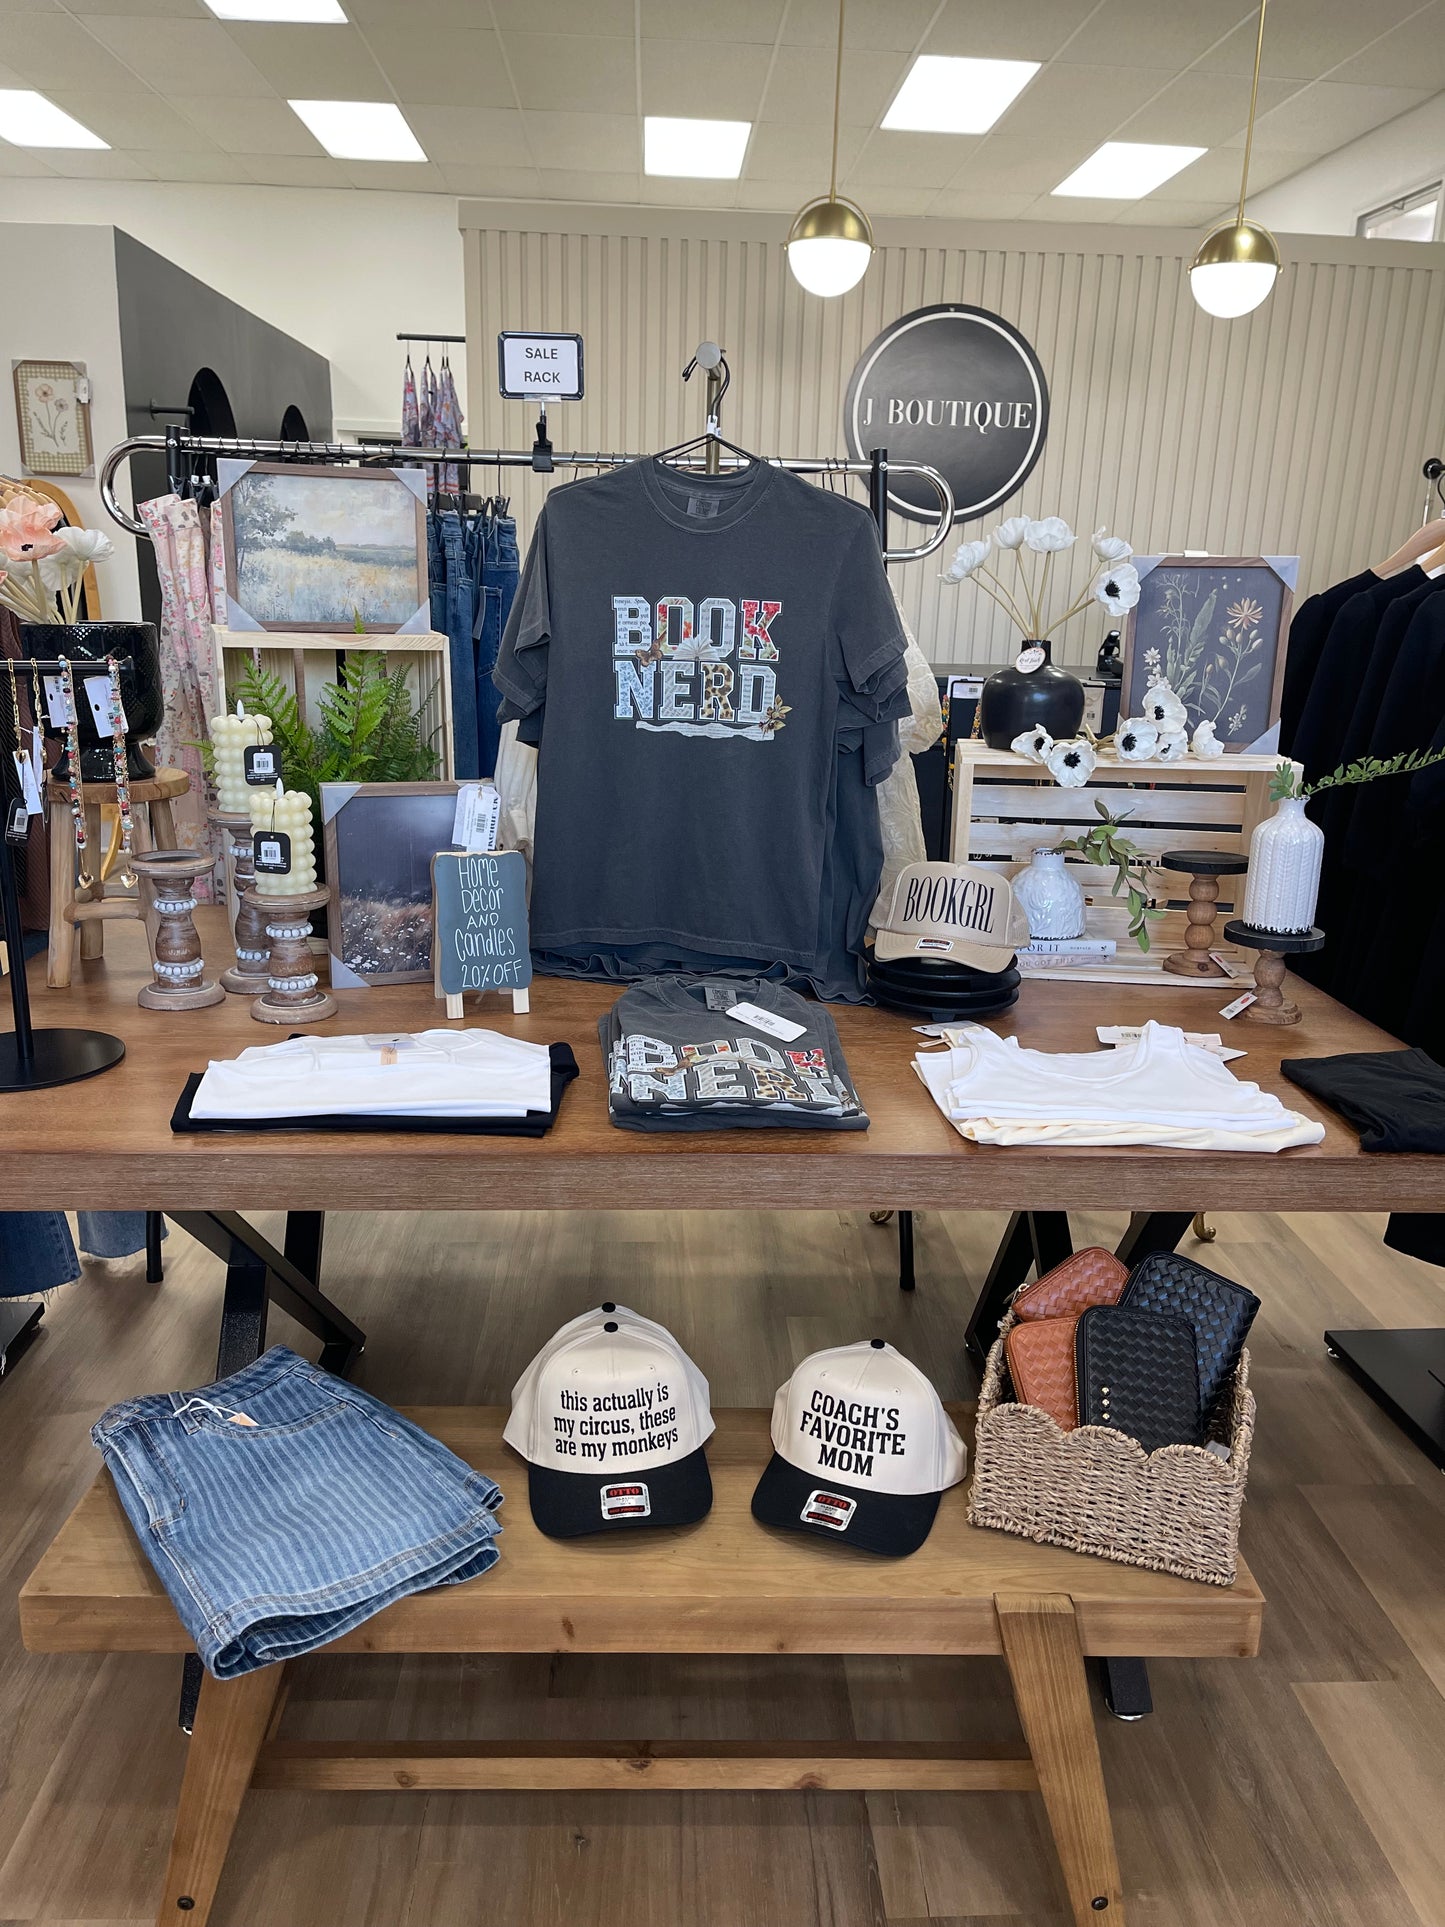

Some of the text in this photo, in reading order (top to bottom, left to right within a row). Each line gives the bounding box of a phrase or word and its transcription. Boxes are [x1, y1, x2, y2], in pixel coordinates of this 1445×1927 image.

[525, 347, 558, 359] SALE
[524, 371, 560, 383] RACK
[863, 398, 1032, 434] J BOUTIQUE
[612, 596, 783, 664] BOOK
[613, 659, 778, 724] NERD
[461, 888, 504, 914] Decor
[902, 876, 995, 933] BOOKGRL
[466, 912, 499, 930] AND
[455, 927, 516, 962] Candles
[1049, 944, 1060, 952] IT
[1034, 959, 1051, 967] GOT
[1055, 956, 1075, 966] THIS
[561, 1382, 669, 1412] this actually is
[811, 1390, 899, 1431] COACH'S
[554, 1406, 676, 1438] my circus, these
[800, 1410, 906, 1455] FAVORITE
[555, 1428, 678, 1461] are my monkeys
[817, 1443, 874, 1477] MOM
[609, 1487, 640, 1496] OTTO
[817, 1495, 848, 1508] OTTO
